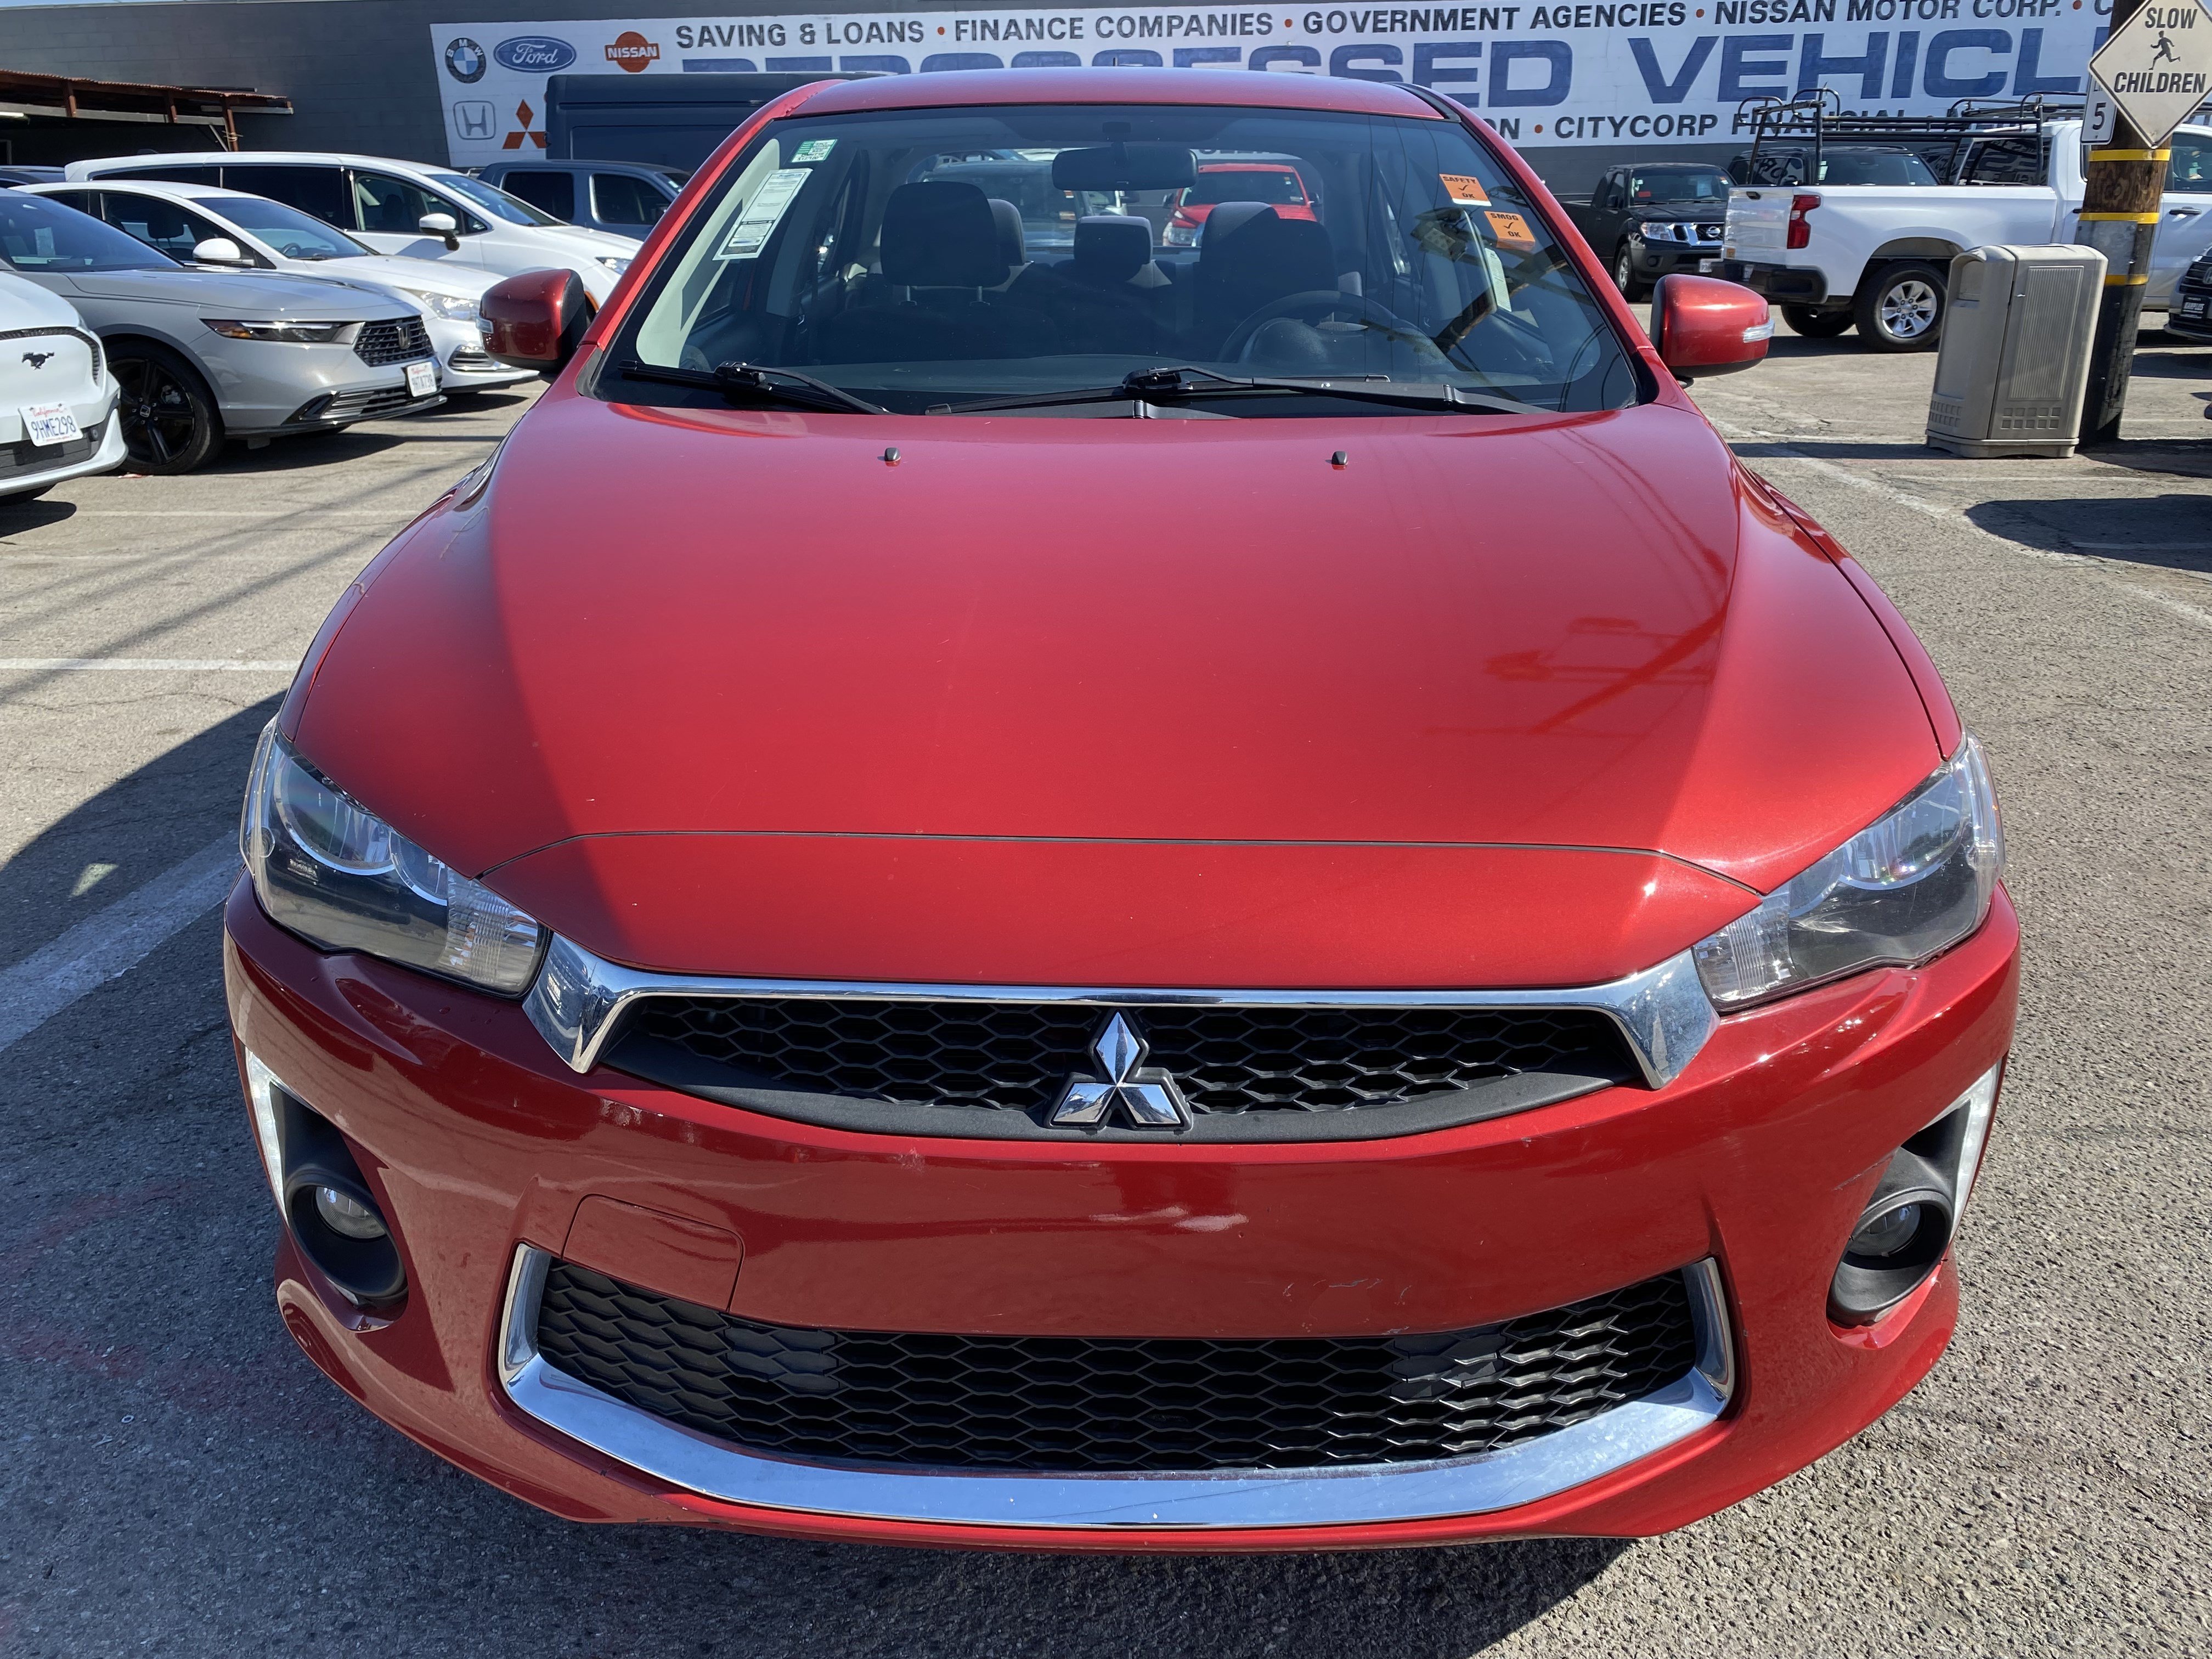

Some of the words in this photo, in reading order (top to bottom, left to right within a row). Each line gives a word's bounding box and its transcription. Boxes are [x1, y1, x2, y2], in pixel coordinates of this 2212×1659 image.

[676, 23, 786, 49] SAVING
[799, 23, 816, 45] &
[827, 20, 924, 44] LOANS
[955, 17, 1084, 41] FINANCE
[1096, 13, 1273, 38] COMPANIES
[1303, 6, 1520, 34] GOVERNMENT
[1530, 3, 1686, 29] AGENCIES
[1715, 0, 1837, 25] NISSAN
[1847, 0, 1959, 22] MOTOR
[1973, 0, 2061, 18] CORP.
[2145, 7, 2198, 29] SLOW
[512, 43, 558, 64] Ford
[607, 46, 658, 59] NISSAN
[1628, 26, 2111, 104] VEHICL
[2114, 72, 2207, 93] CHILDREN
[1555, 114, 1718, 139] CITYCORP
[2092, 102, 2107, 130] 5
[1442, 176, 1477, 184] SAFETY
[31, 415, 76, 439] 9HME298
